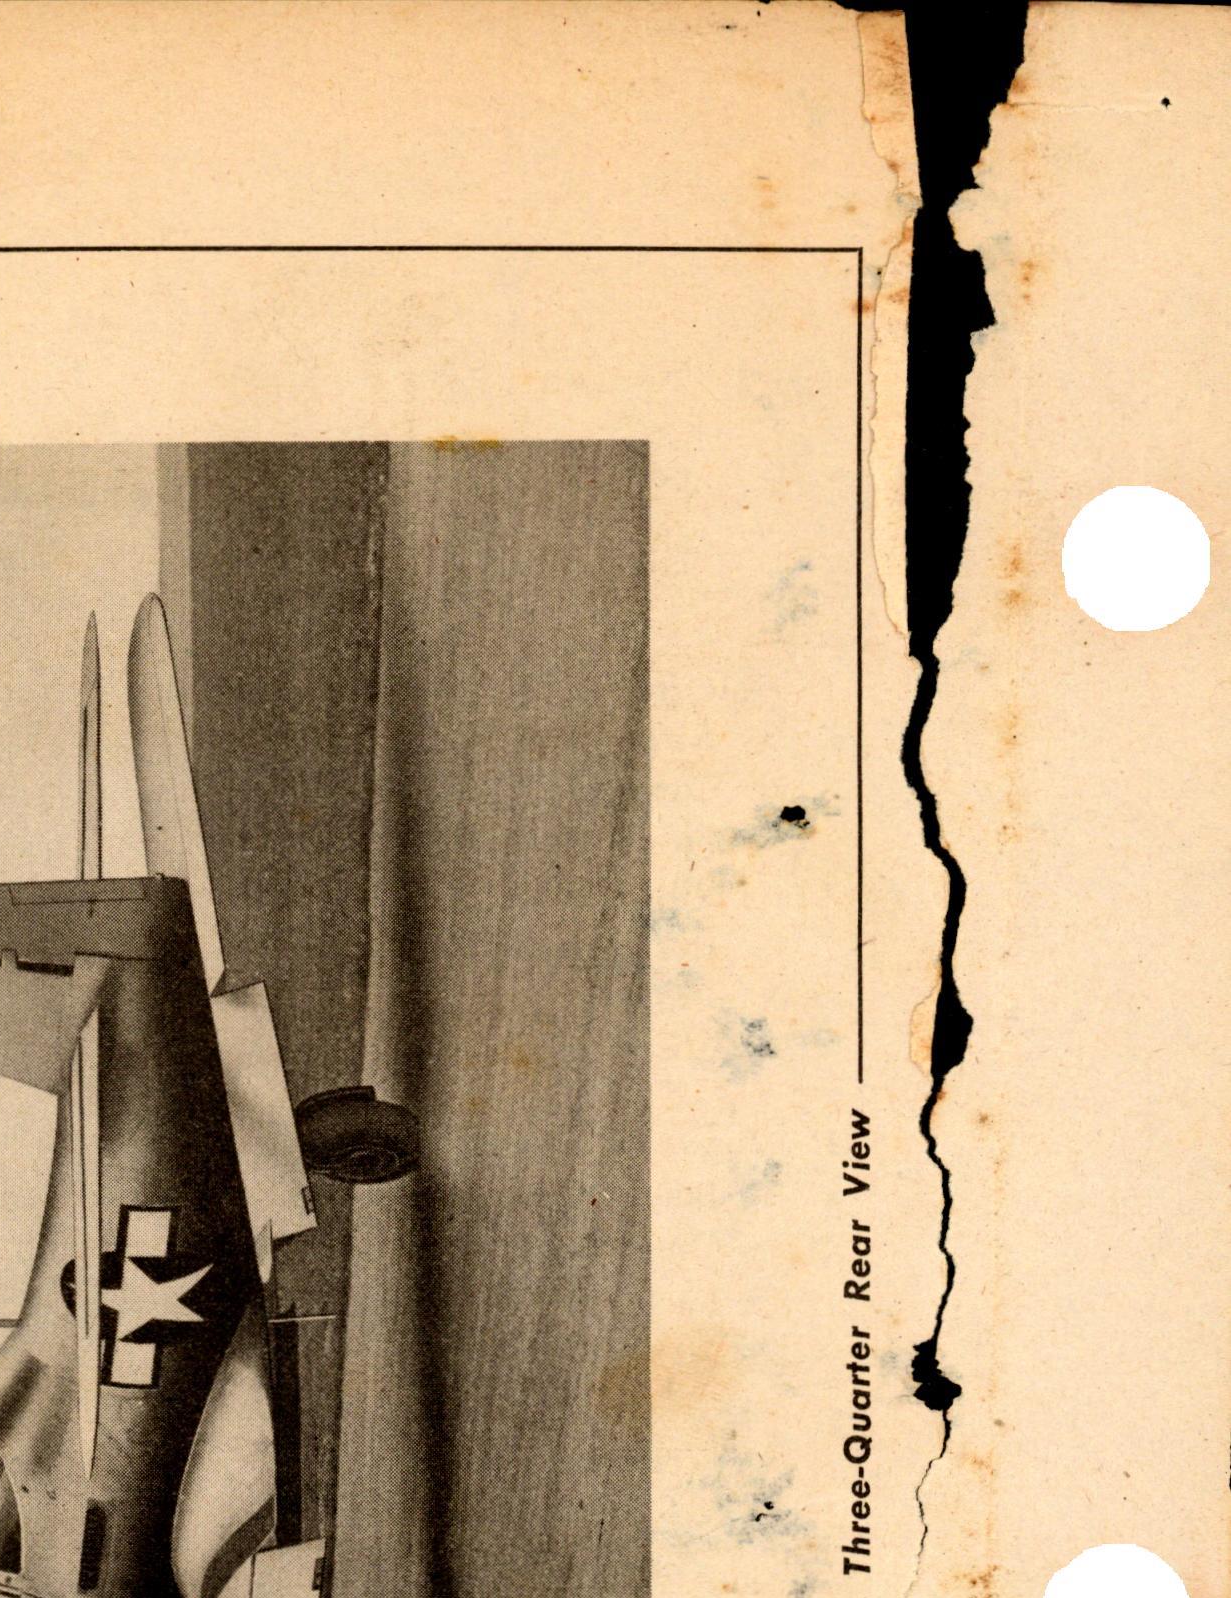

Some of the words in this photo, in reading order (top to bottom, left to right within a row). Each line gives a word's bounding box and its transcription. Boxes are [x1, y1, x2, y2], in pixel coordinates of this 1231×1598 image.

[842, 1108, 871, 1197] View
[843, 1219, 871, 1302] Rear
[841, 1325, 873, 1575] Three-Quarter
